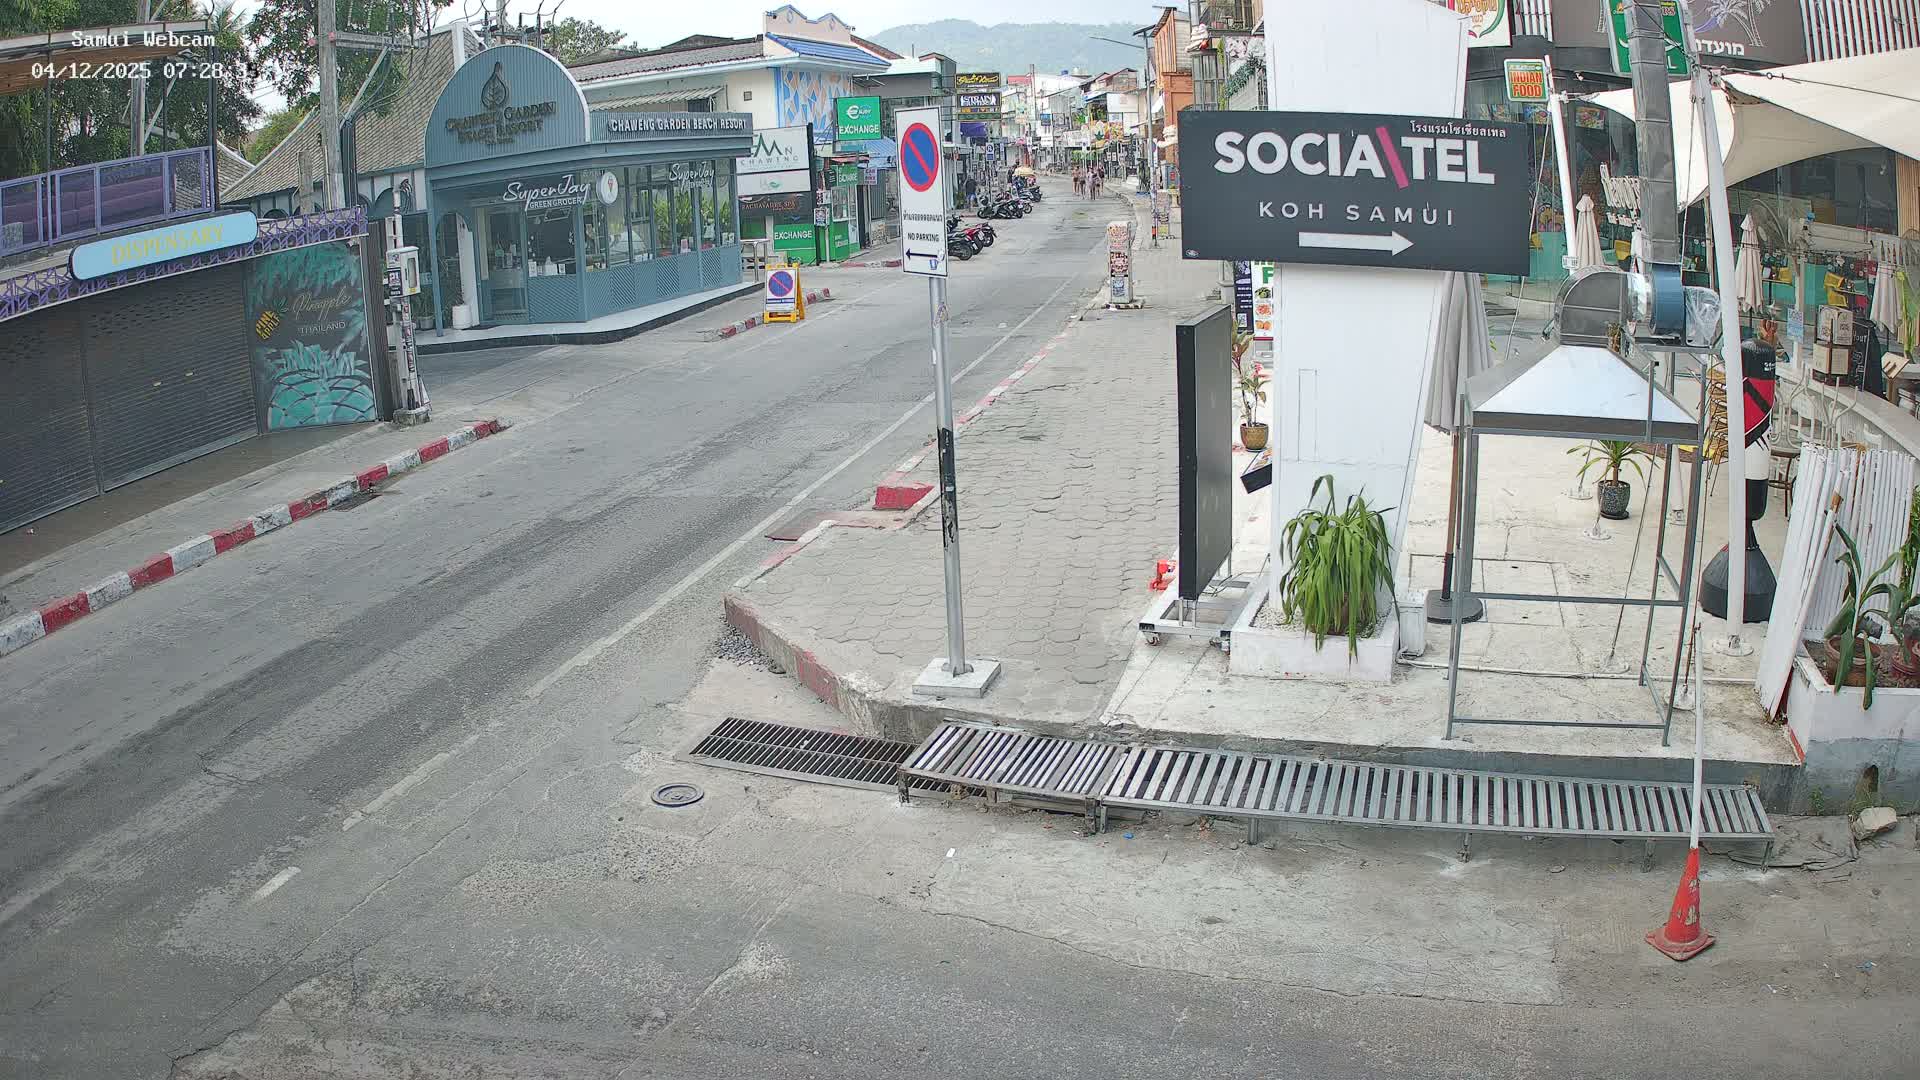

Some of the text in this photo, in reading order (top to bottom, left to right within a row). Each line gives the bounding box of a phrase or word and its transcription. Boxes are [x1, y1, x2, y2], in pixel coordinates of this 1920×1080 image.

[1509, 70, 1543, 84] INDIAN
[1512, 83, 1543, 97] FOOD
[503, 102, 558, 121] GARDEN
[610, 117, 748, 132] CHAWENG GARDEN BEACH RESORT
[839, 124, 880, 135] EXCHANGE
[1410, 119, 1507, 138] โรงแรมโซเชียลเทล
[740, 155, 799, 166] CHAWENG
[529, 197, 553, 210] GREEN
[1259, 201, 1454, 226] KOH SAMUI
[774, 230, 813, 241] EXCHANGE
[907, 232, 940, 243] NO PARKING
[111, 223, 224, 266] DISPENSARY
[292, 285, 352, 321] Pineapple
[298, 321, 346, 335] THAILAND
